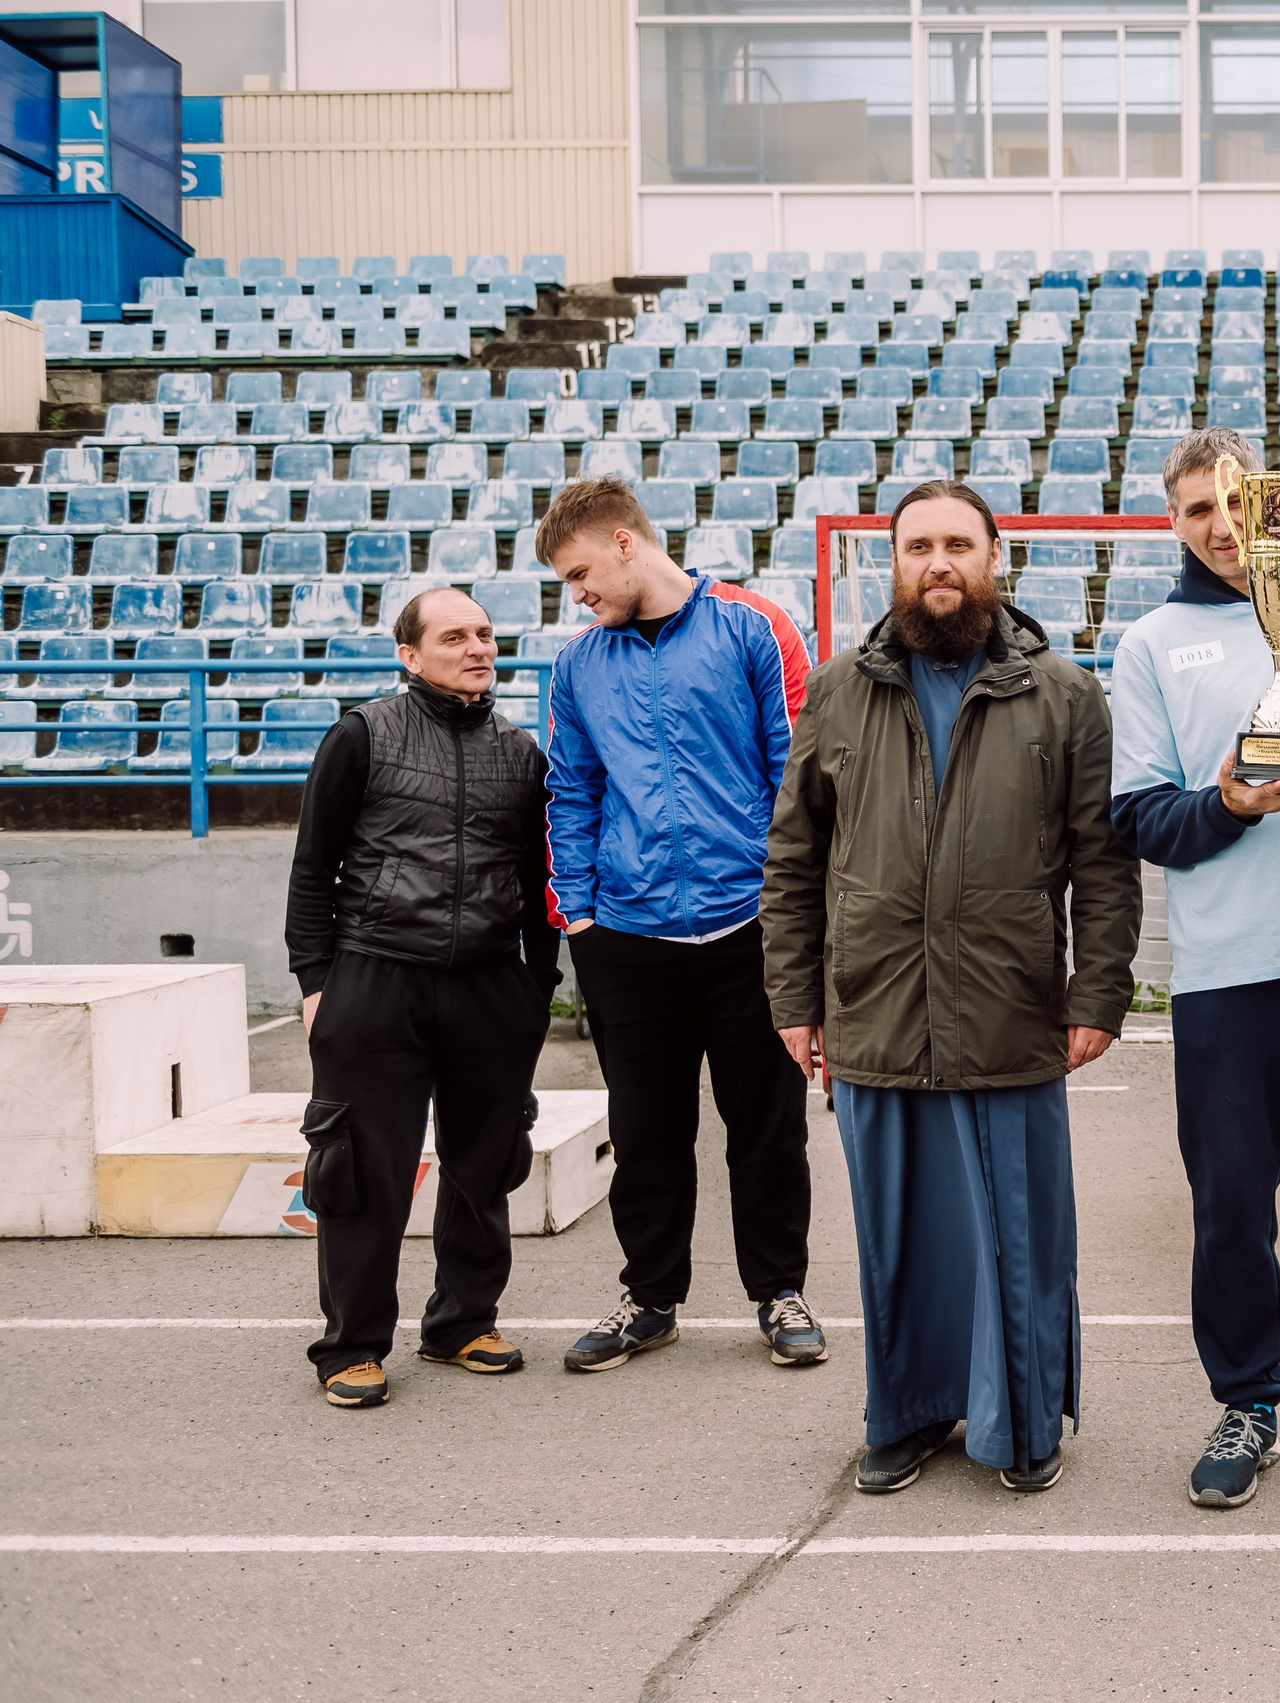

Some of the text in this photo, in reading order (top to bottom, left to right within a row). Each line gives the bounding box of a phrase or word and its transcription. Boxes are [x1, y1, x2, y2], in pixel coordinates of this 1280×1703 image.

[604, 317, 635, 343] 12
[575, 341, 601, 369] 11
[560, 368, 578, 397] 0
[14, 465, 34, 486] 7
[1179, 648, 1213, 665] 1018
